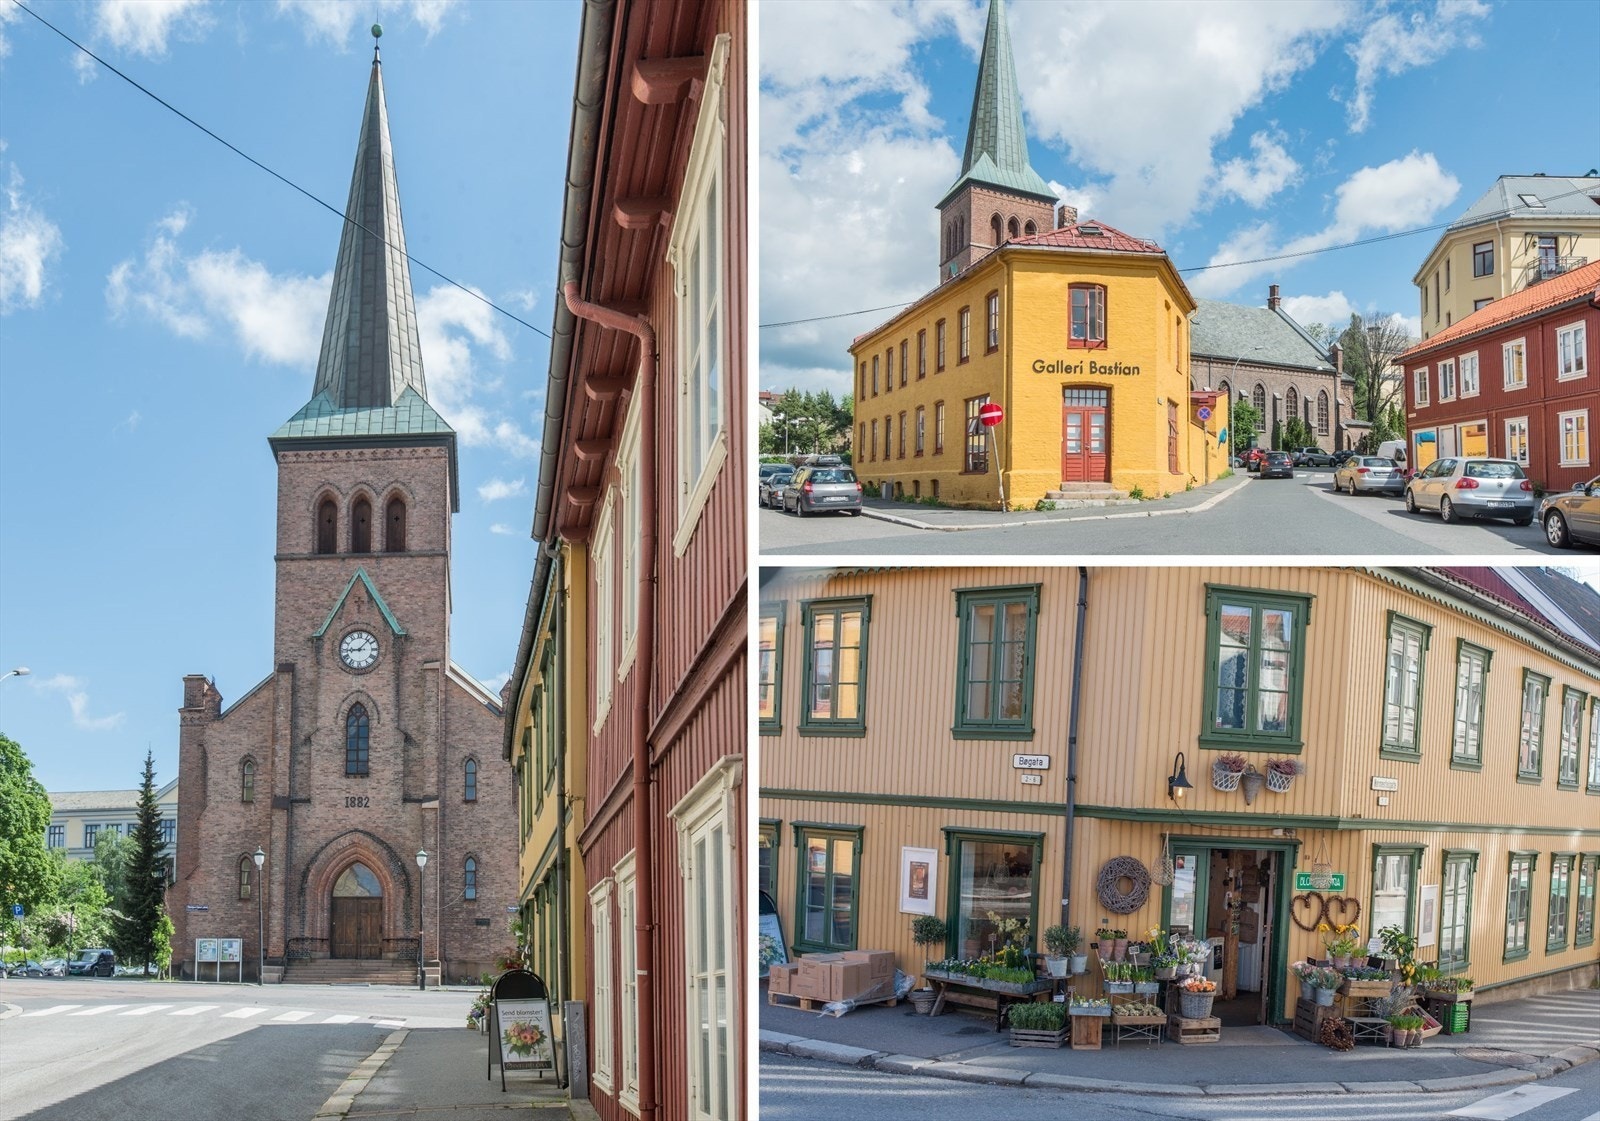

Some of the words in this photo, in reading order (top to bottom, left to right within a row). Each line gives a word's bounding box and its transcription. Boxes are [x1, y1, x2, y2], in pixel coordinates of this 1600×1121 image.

[1032, 359, 1083, 374] Galleri
[1089, 360, 1140, 376] Bastian
[344, 796, 370, 808] 1882
[15, 906, 22, 914] P
